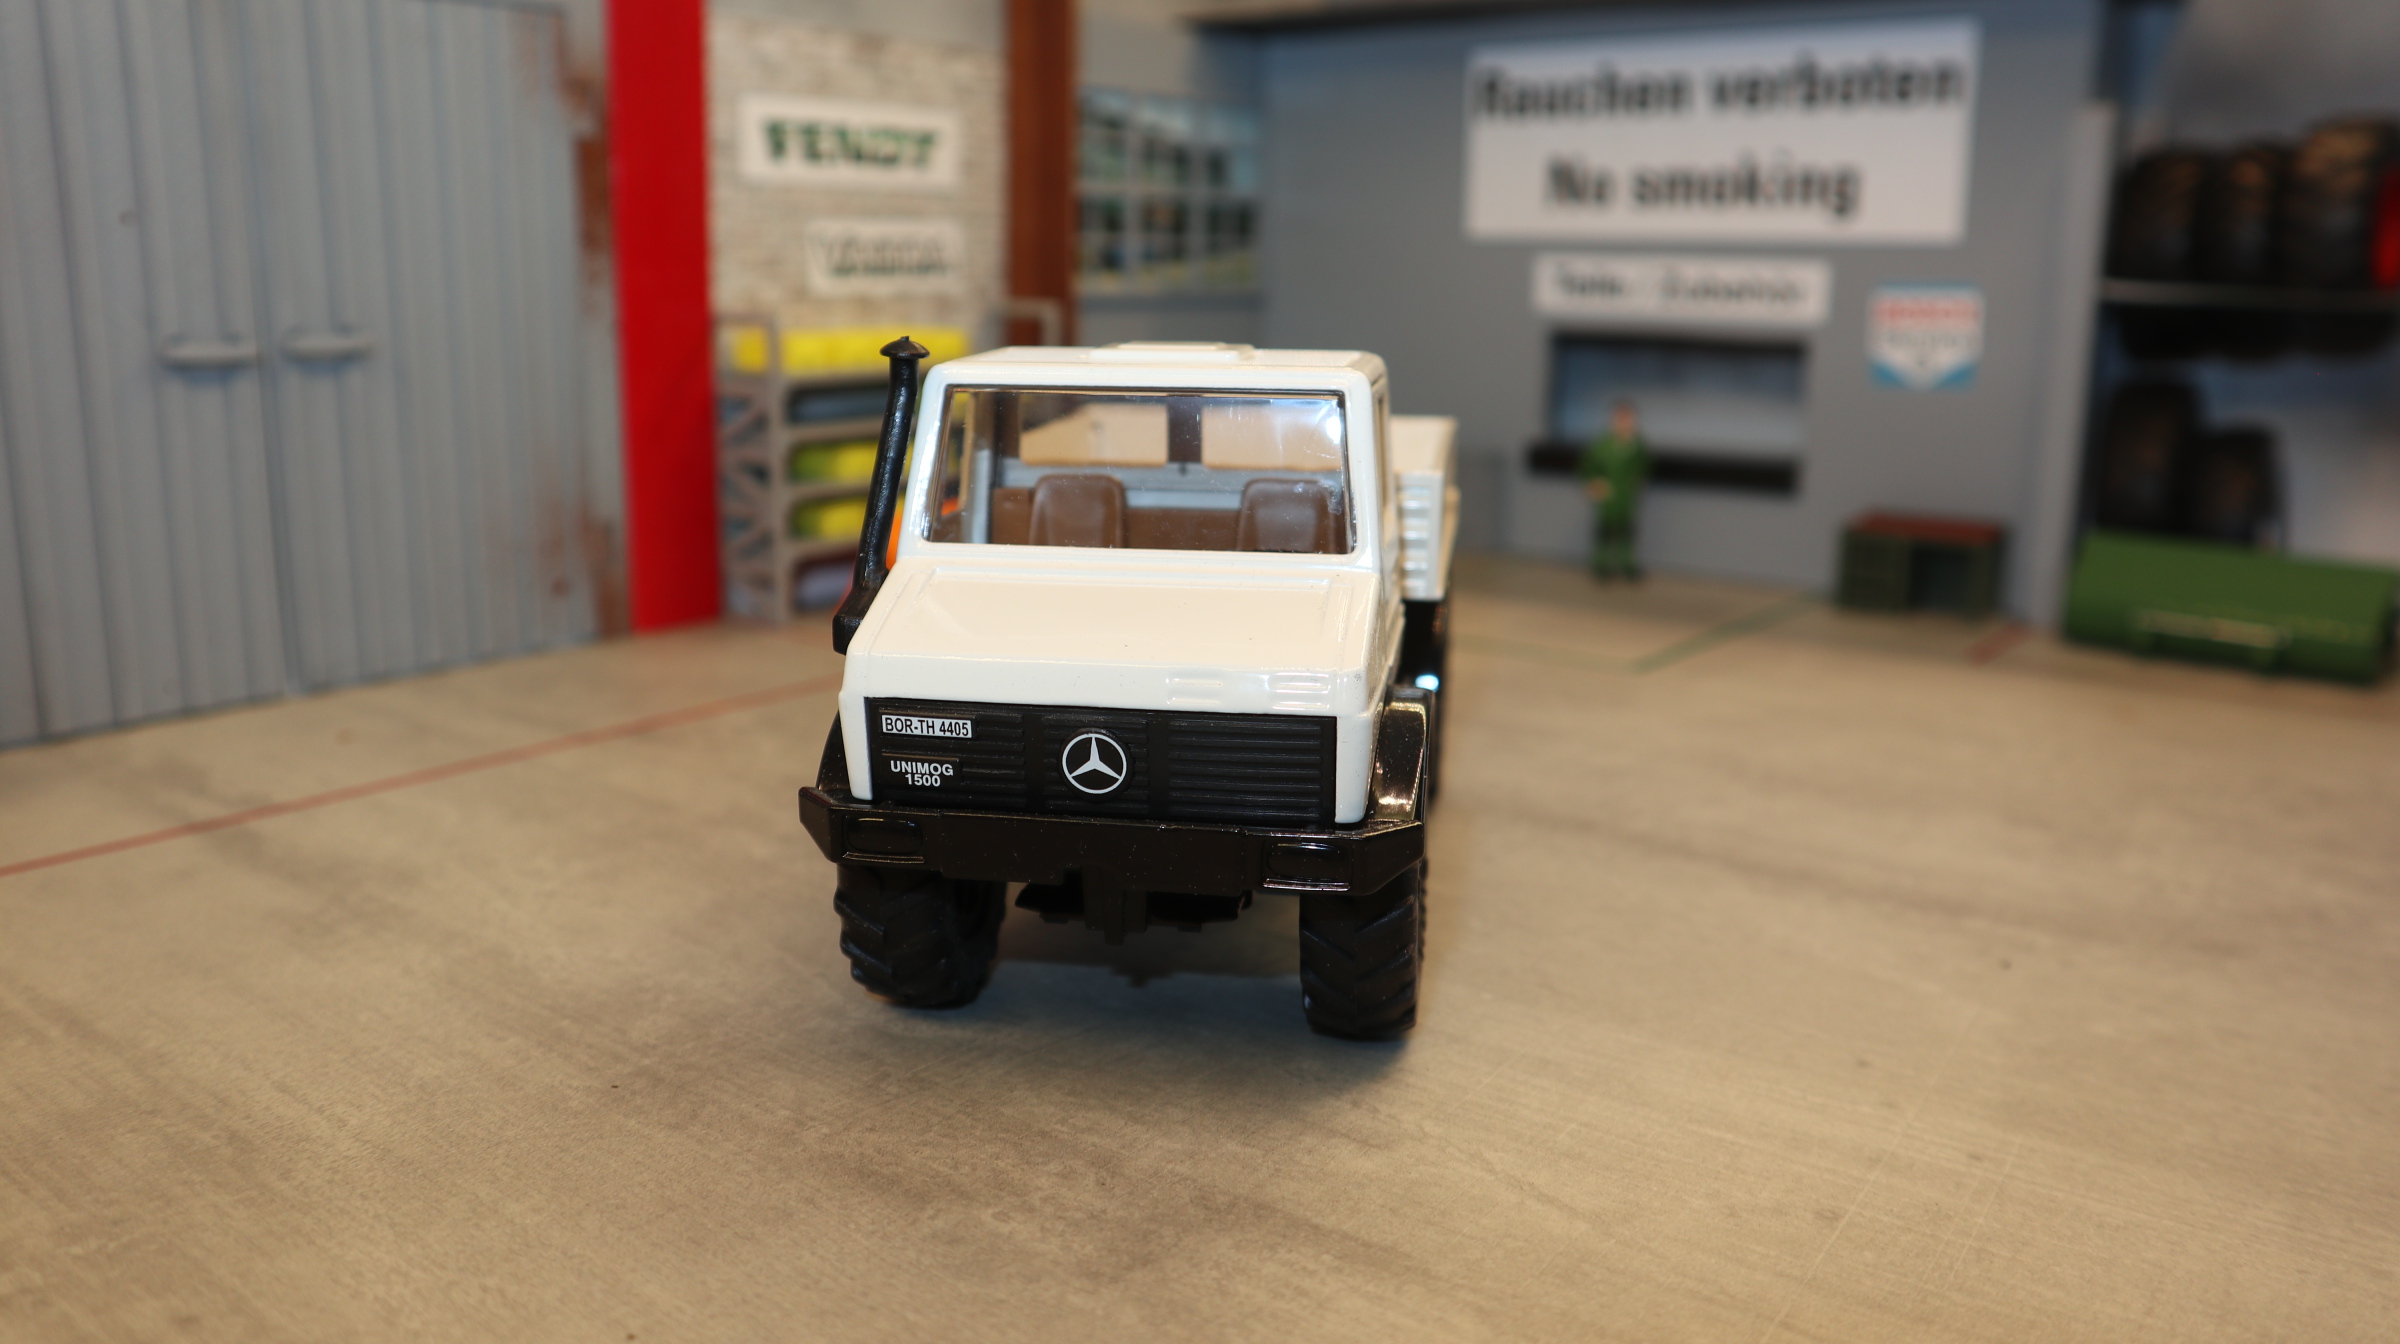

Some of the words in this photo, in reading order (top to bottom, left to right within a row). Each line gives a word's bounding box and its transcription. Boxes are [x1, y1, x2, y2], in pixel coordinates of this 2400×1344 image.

[1473, 63, 1691, 118] Rauchen
[1709, 52, 1965, 110] verboten
[1546, 157, 1612, 208] No
[1633, 151, 1859, 221] smoking
[885, 717, 936, 735] BOR-TH
[938, 720, 969, 737] 4405
[890, 760, 954, 776] UNIMOG
[904, 774, 941, 787] 1500
